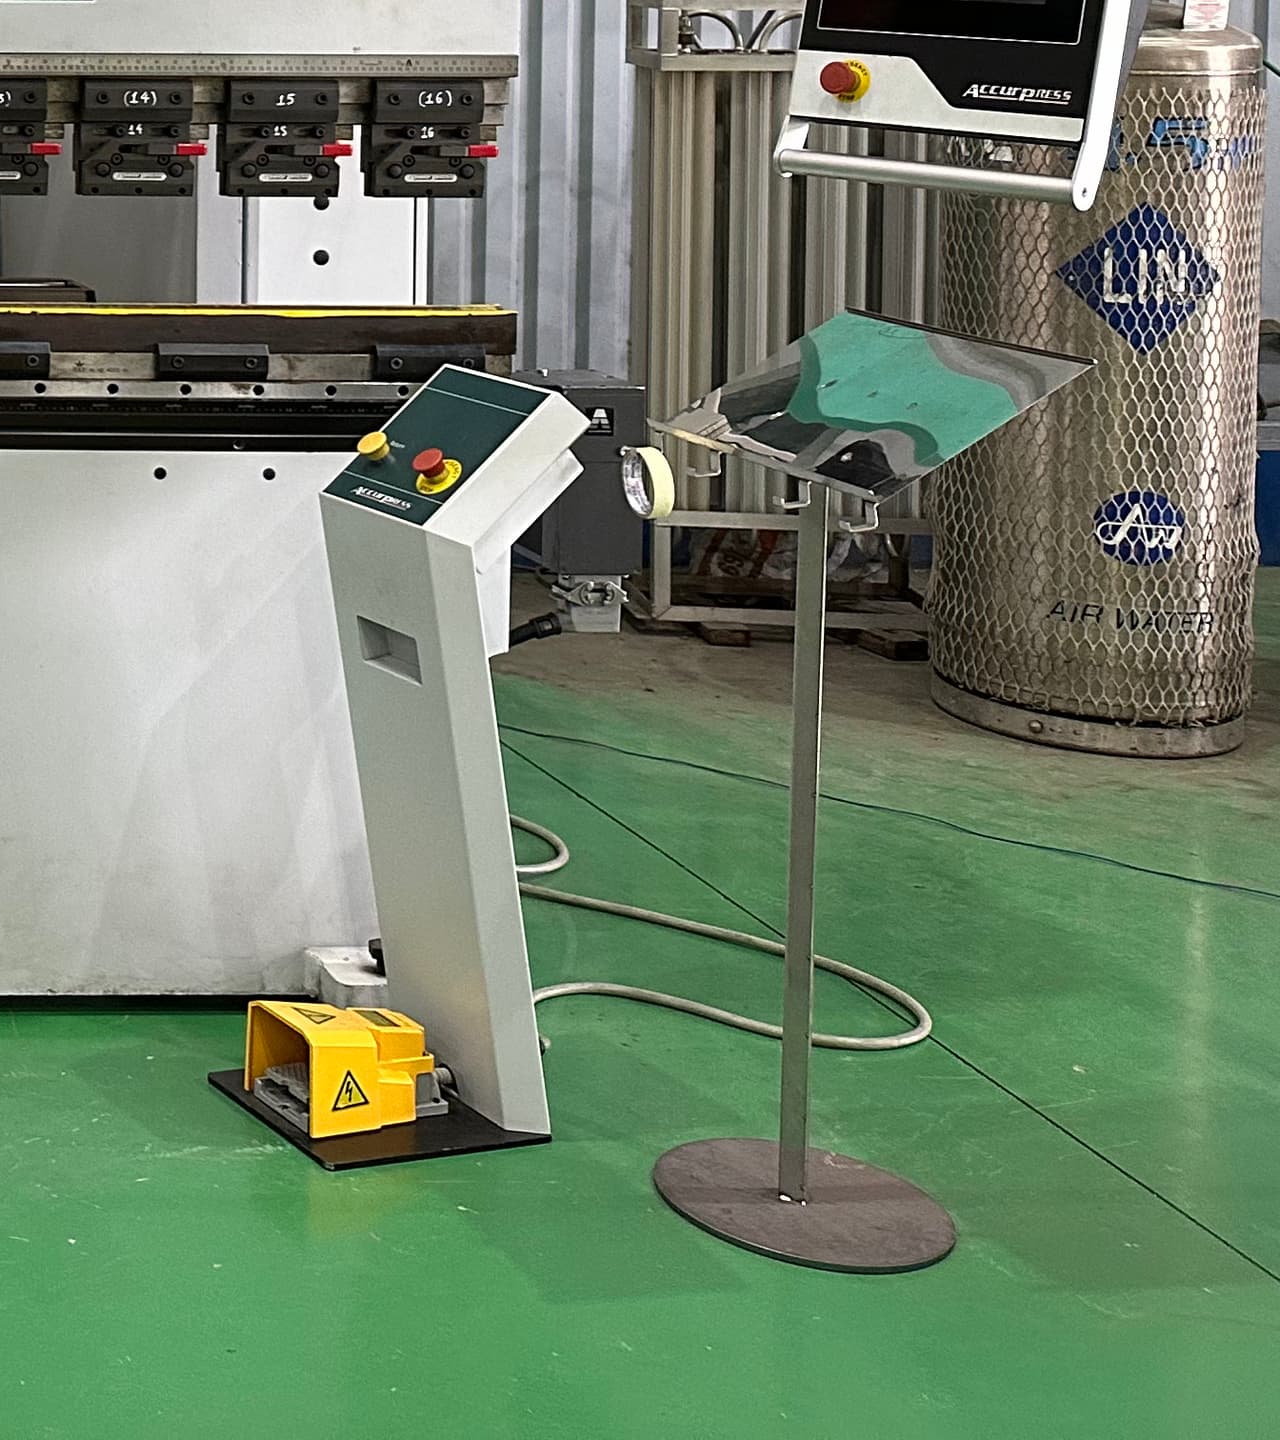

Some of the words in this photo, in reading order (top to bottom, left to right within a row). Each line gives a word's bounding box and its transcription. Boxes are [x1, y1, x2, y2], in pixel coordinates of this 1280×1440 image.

[127, 124, 143, 136] 14
[273, 125, 288, 137] 15
[420, 126, 435, 139] 16
[1102, 246, 1189, 305] LIN
[1047, 599, 1105, 624] AIR
[1114, 608, 1215, 633] WATER
